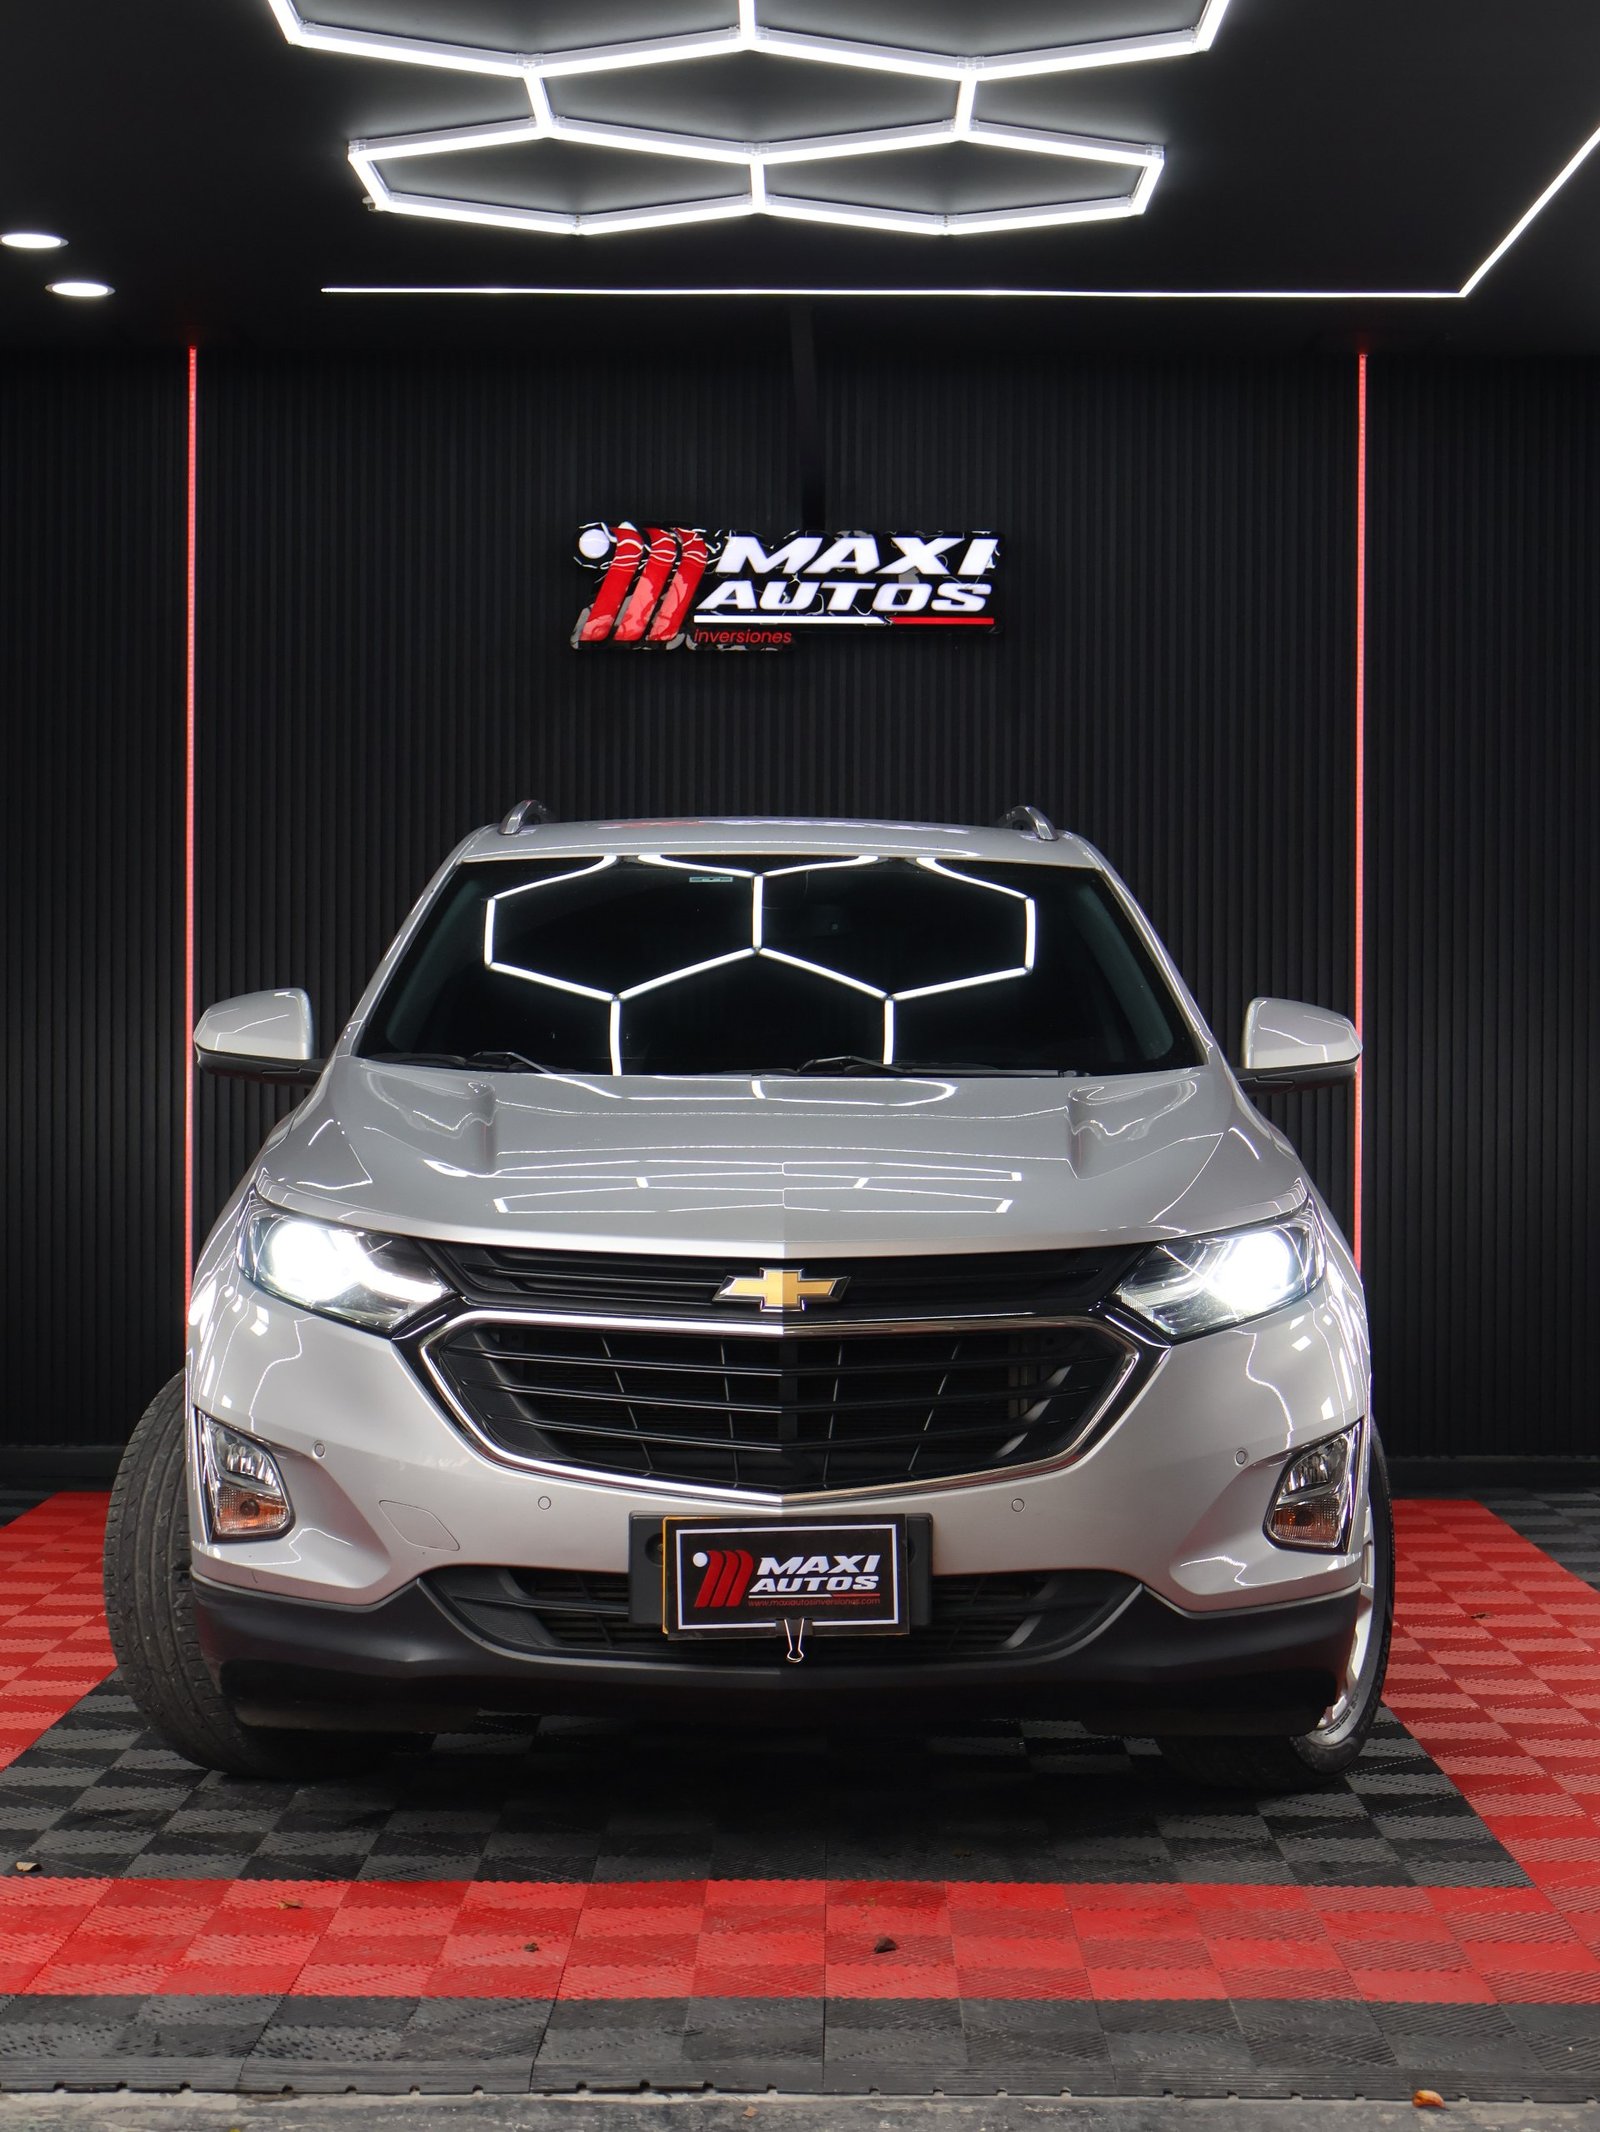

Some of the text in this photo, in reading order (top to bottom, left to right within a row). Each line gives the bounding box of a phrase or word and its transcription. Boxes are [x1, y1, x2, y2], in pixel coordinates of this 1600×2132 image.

[714, 536, 999, 576] MAXI
[695, 581, 992, 612] AUTOS
[694, 629, 792, 643] inversiones
[756, 1554, 881, 1576] MAXI
[749, 1575, 879, 1593] AUTOS
